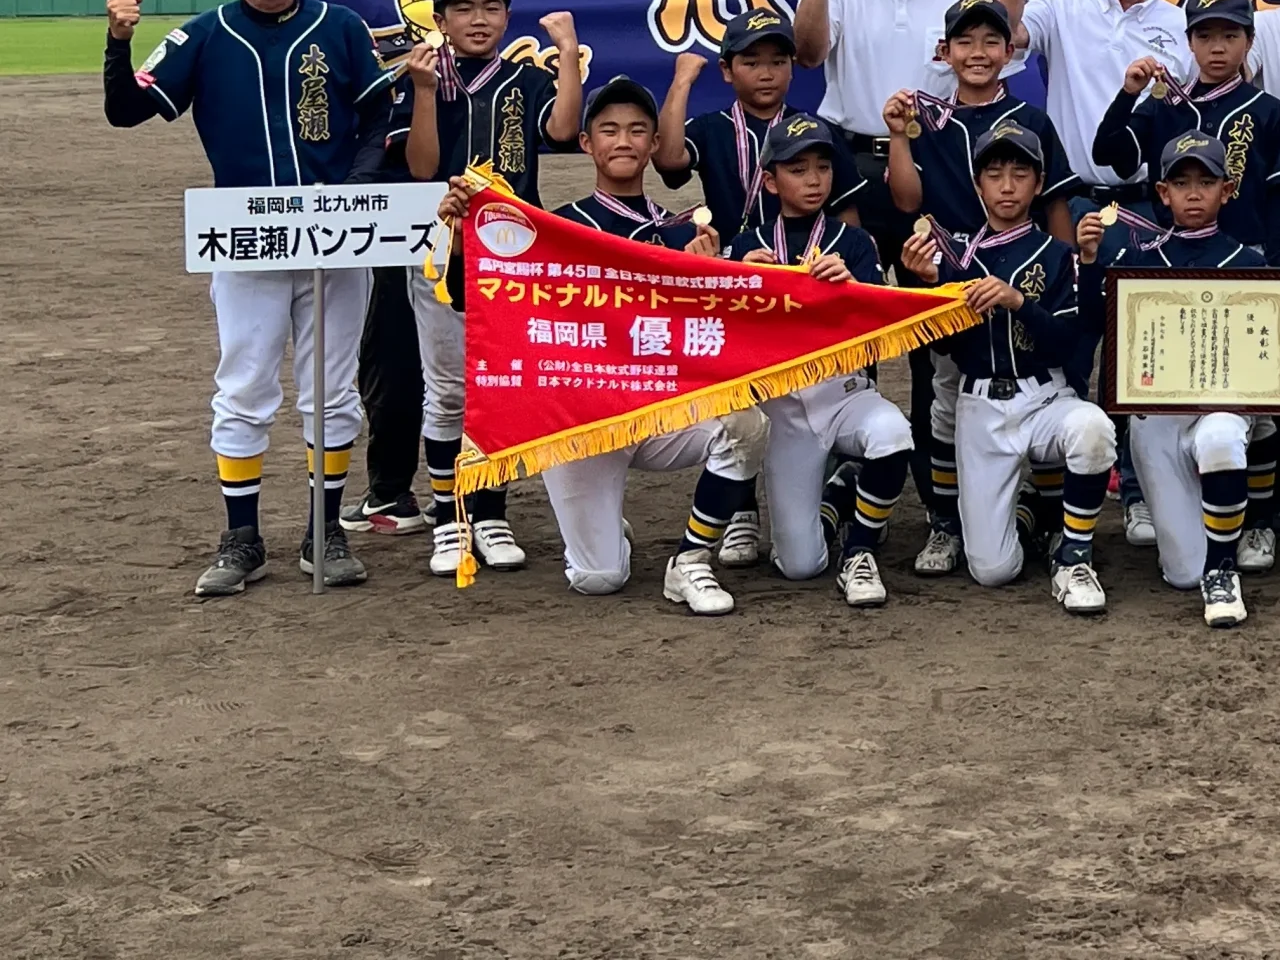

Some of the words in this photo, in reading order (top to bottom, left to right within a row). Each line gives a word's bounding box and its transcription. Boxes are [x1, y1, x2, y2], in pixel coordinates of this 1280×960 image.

[297, 43, 330, 141] 木屋瀬
[499, 87, 526, 174] 木屋瀬
[247, 197, 305, 215] 福岡県
[313, 194, 389, 213] 北九州市
[198, 220, 438, 262] 木屋瀬バンブーズ
[478, 257, 544, 277] 高円宮賜杯
[547, 262, 601, 280] 第45回
[604, 267, 764, 290] 全日本学童軟式野球大会
[476, 277, 804, 314] マクドナルド・トーナメント
[527, 317, 607, 349] 福岡県
[629, 314, 726, 358] 優勝
[1258, 325, 1270, 361] 表彰状
[536, 376, 679, 393] 日本マクドナルド株式会社
